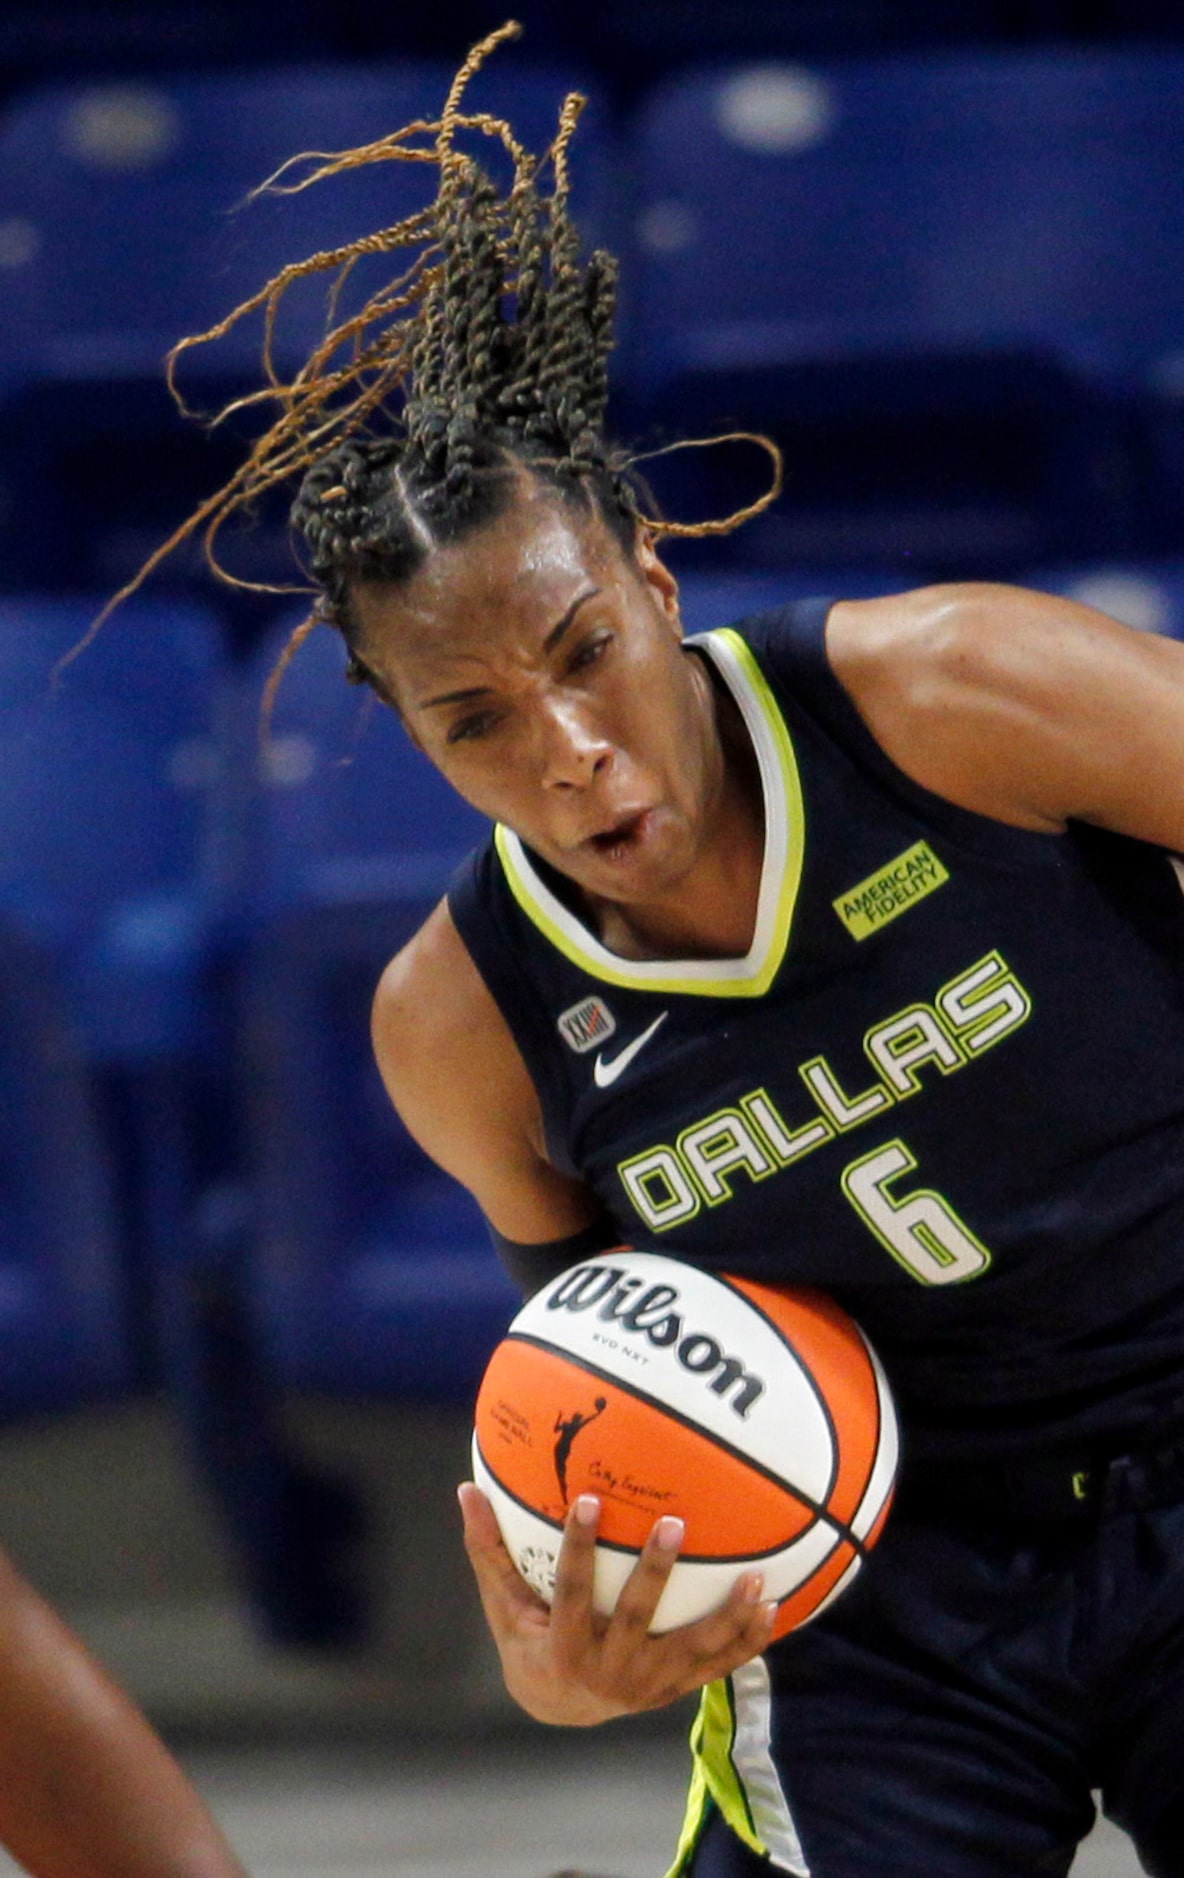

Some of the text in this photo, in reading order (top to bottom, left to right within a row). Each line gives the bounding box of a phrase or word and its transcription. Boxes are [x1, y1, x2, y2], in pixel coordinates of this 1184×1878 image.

[843, 850, 931, 921] AMERICAN
[864, 863, 937, 924] FIDELITY
[617, 949, 1031, 1233] DALLAS
[841, 1137, 991, 1287] 6
[546, 1264, 766, 1420] Wilson
